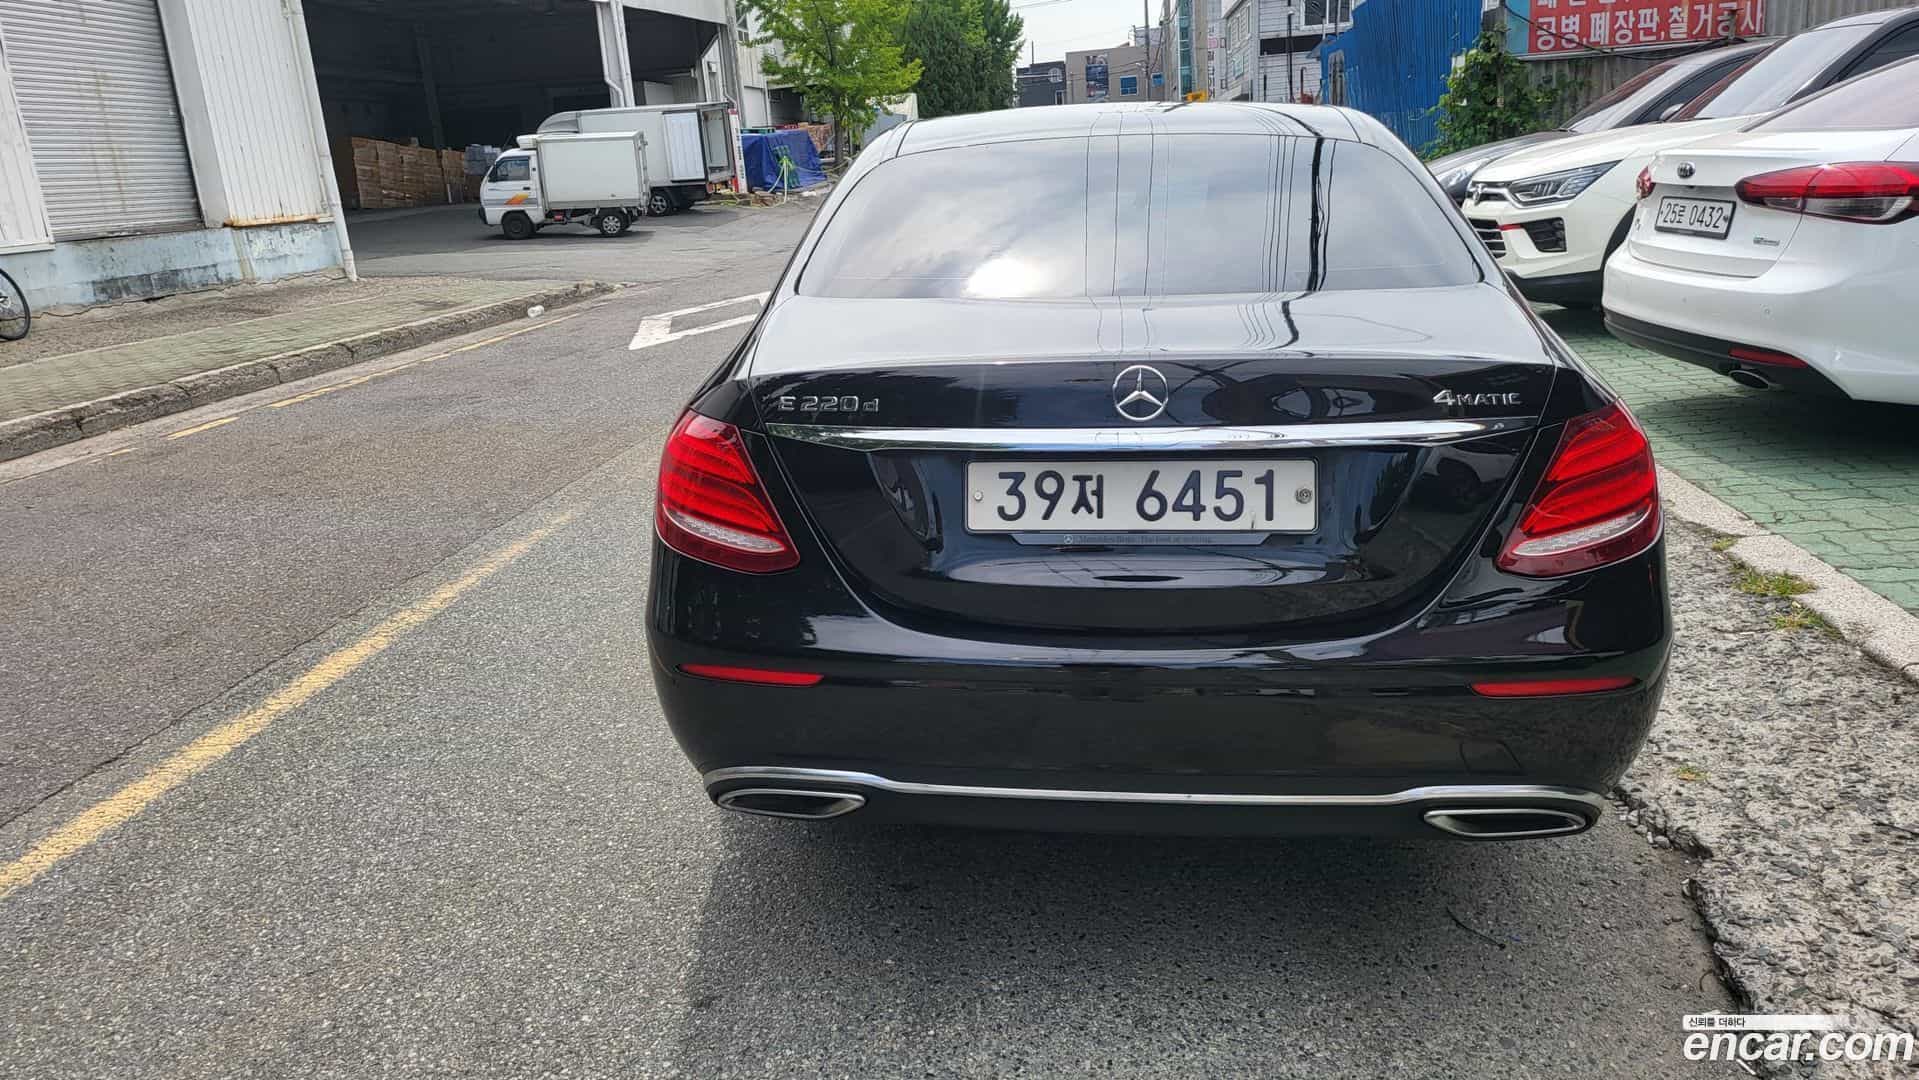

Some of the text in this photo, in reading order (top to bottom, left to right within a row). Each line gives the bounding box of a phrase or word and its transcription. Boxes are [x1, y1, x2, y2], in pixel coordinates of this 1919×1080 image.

[1688, 205, 1724, 229] 0432
[1432, 389, 1522, 406] 4MATIC
[996, 469, 1275, 522] 39저 6451
